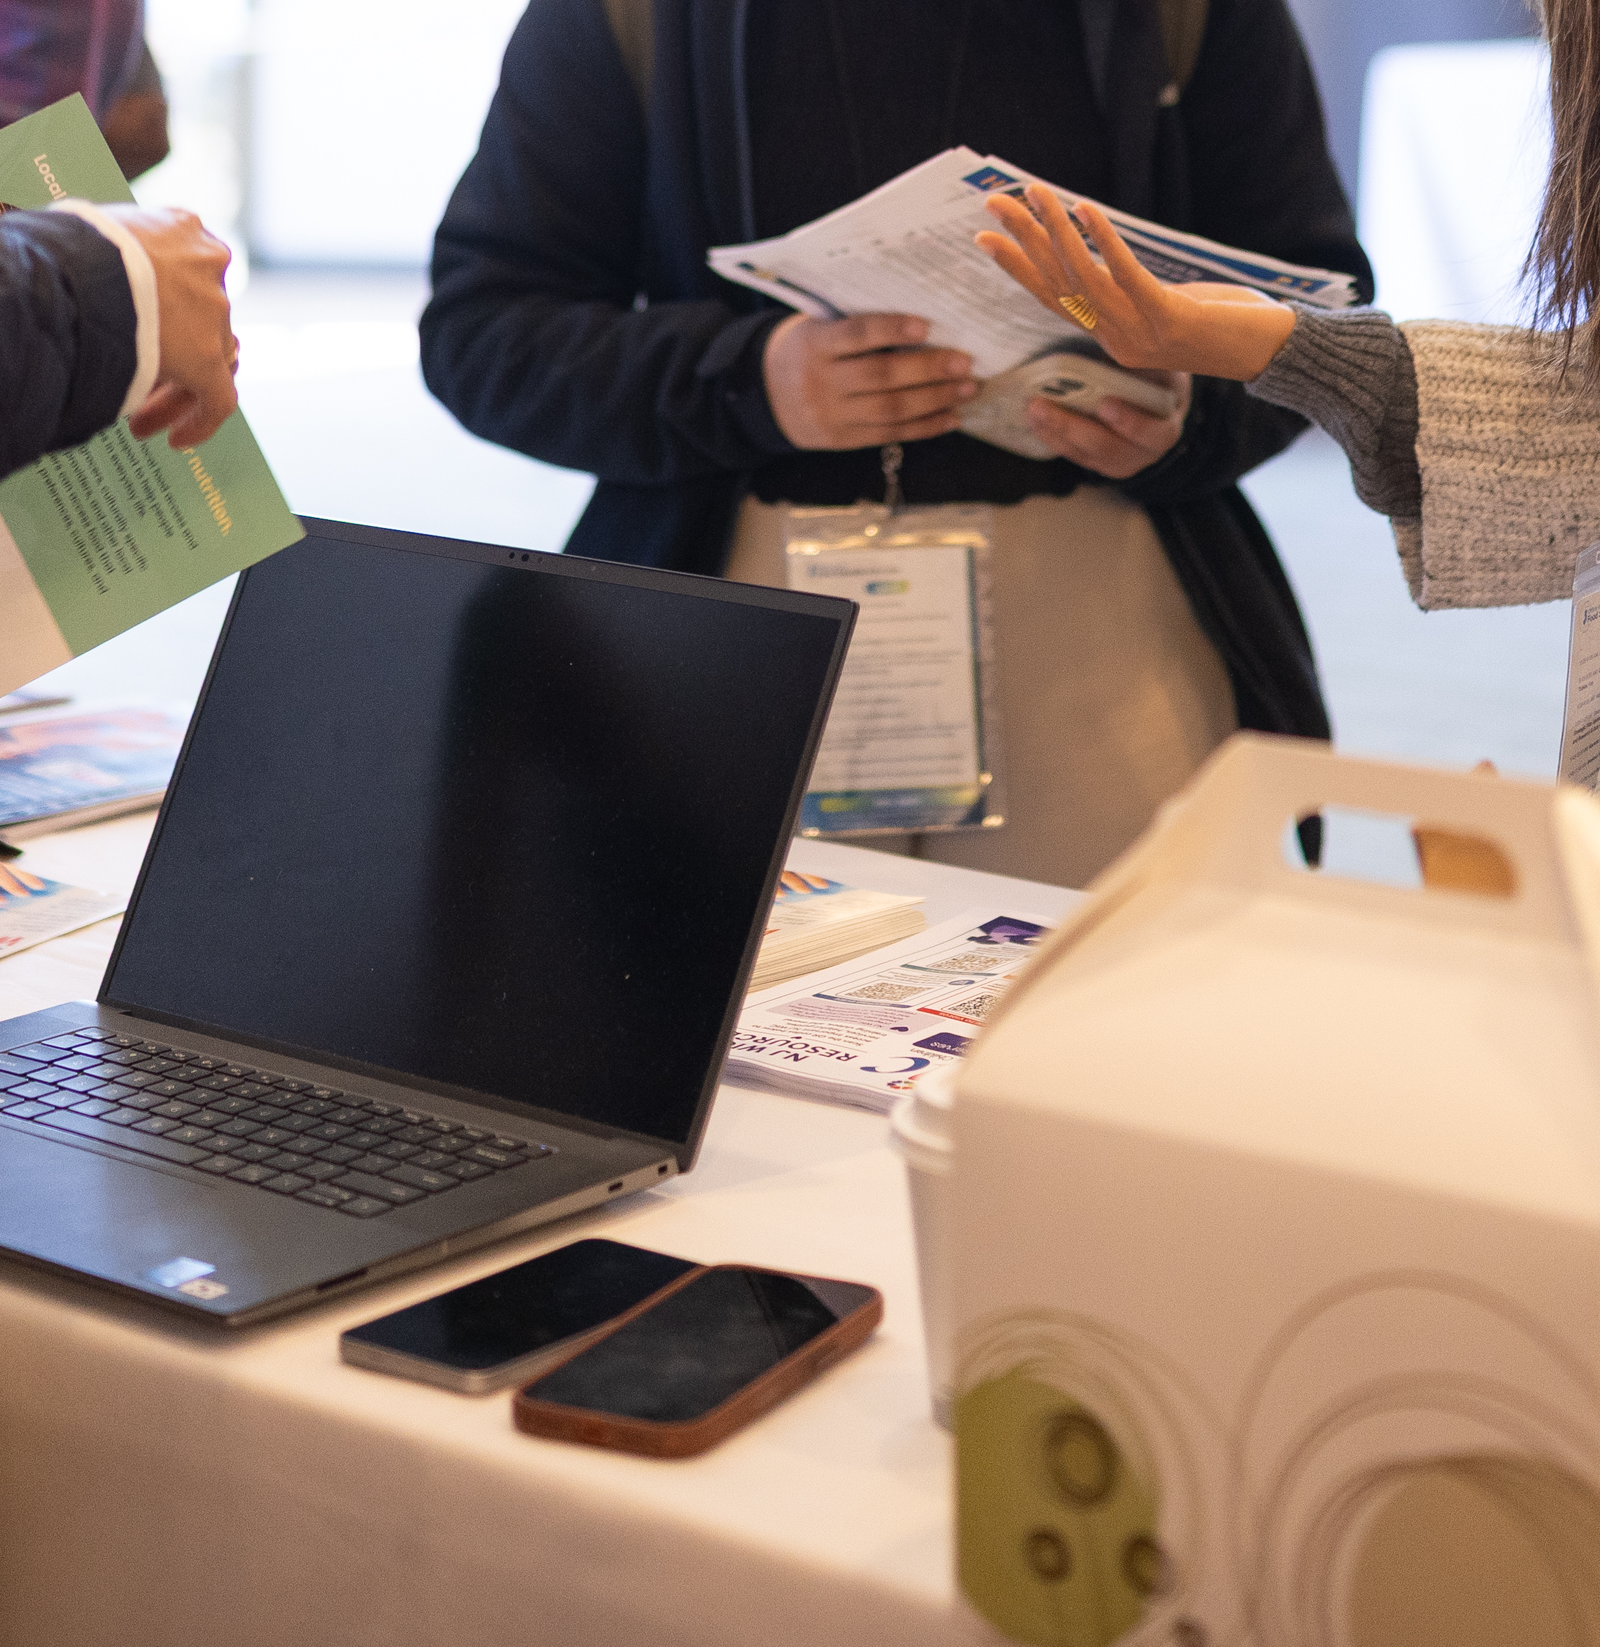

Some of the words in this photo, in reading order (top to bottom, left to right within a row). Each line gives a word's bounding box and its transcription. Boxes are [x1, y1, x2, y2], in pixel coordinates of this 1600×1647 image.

[731, 1042, 767, 1053] WI
[736, 1033, 858, 1062] RESOURC
[769, 1049, 809, 1062] NJ
